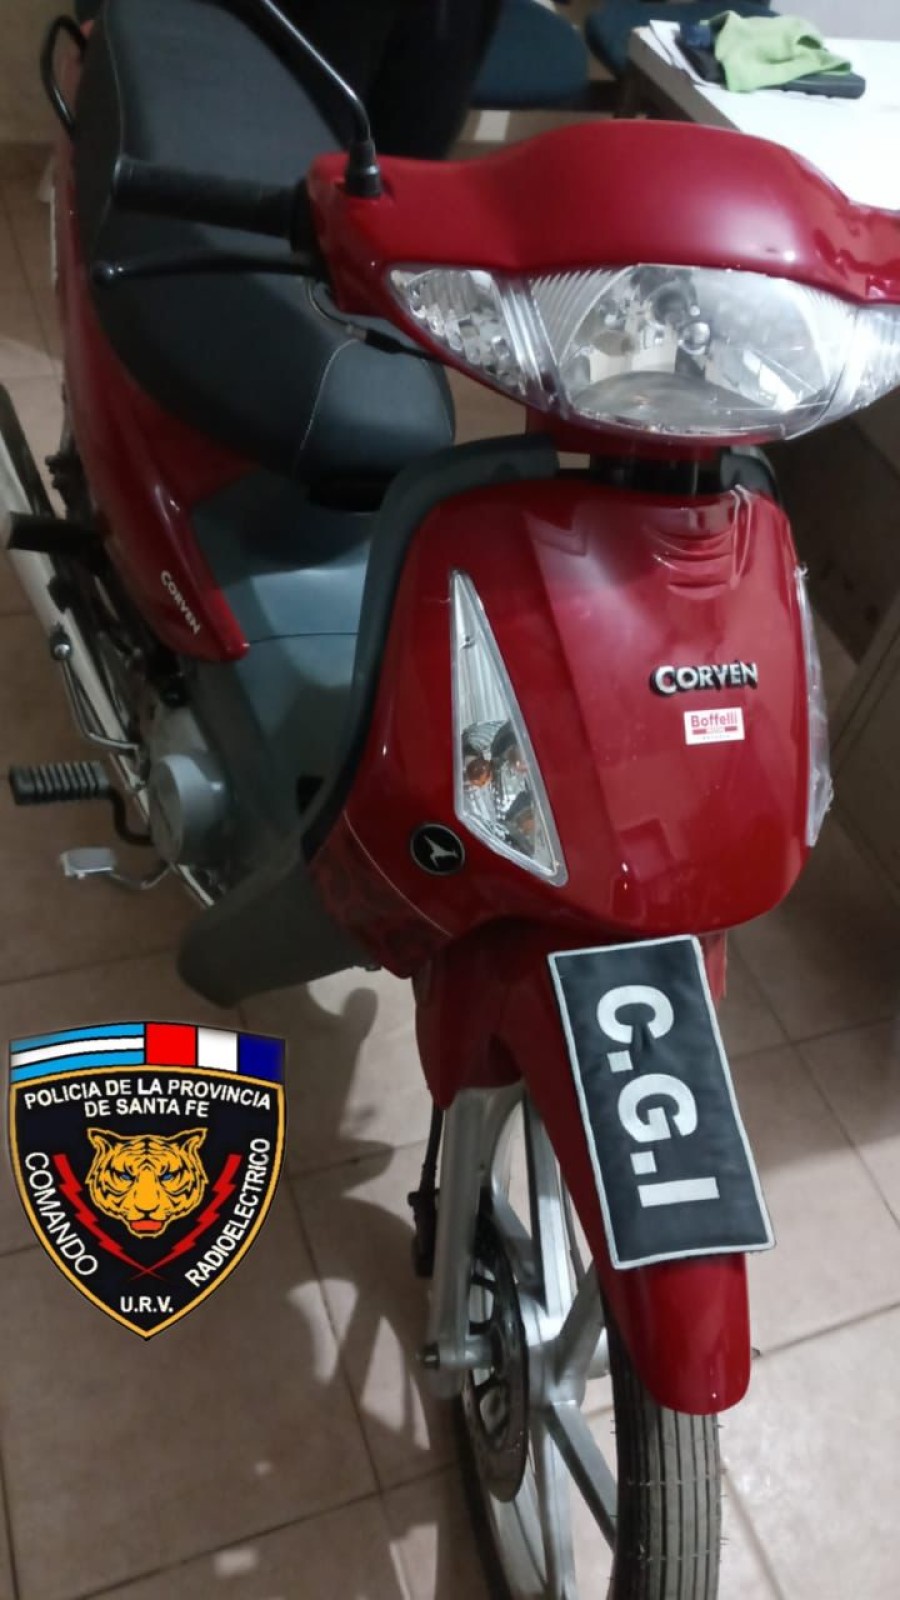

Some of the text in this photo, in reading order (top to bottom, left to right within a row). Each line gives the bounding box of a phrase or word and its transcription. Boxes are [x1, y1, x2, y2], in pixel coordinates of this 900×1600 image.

[161, 570, 200, 635] CORVEN
[651, 661, 758, 695] CORVEN
[690, 711, 738, 727] Boffelli
[597, 985, 720, 1208] C.G.I
